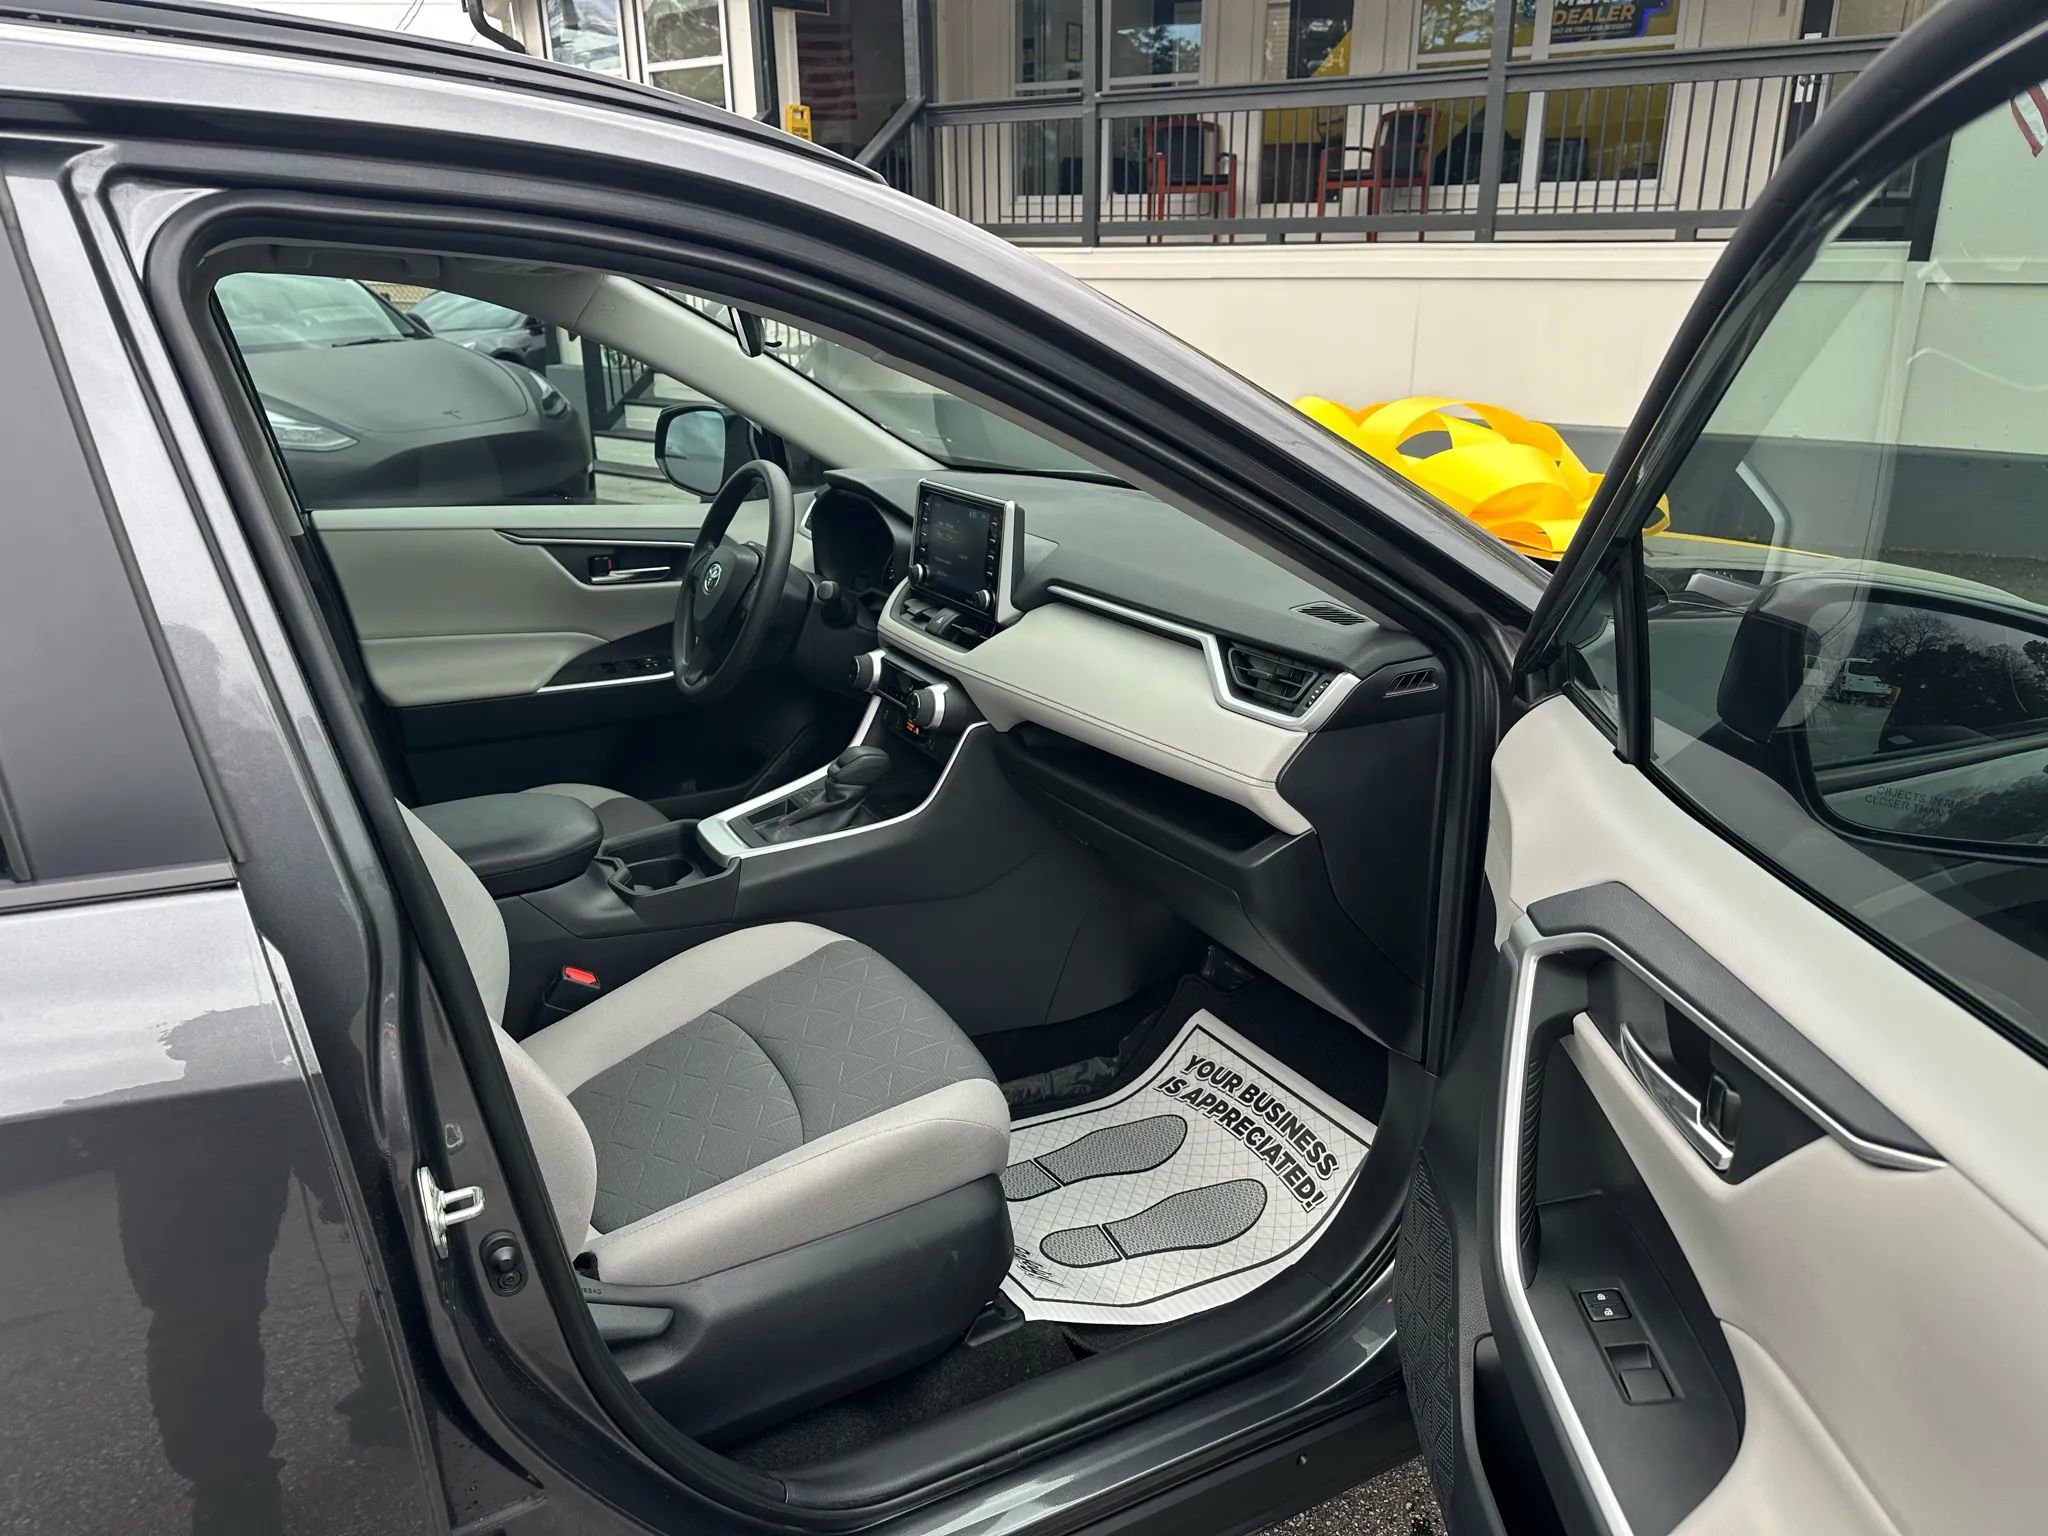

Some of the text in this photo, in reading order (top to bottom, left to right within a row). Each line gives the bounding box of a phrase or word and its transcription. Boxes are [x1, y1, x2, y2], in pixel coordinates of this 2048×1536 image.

[1552, 4, 1636, 24] DEALER
[1865, 794, 1910, 810] CLOSER
[1876, 786, 1927, 803] OBJECTS
[1182, 1054, 1339, 1178] YOUR BUSINESS
[1155, 1075, 1327, 1211] IS APPRECIATED!
